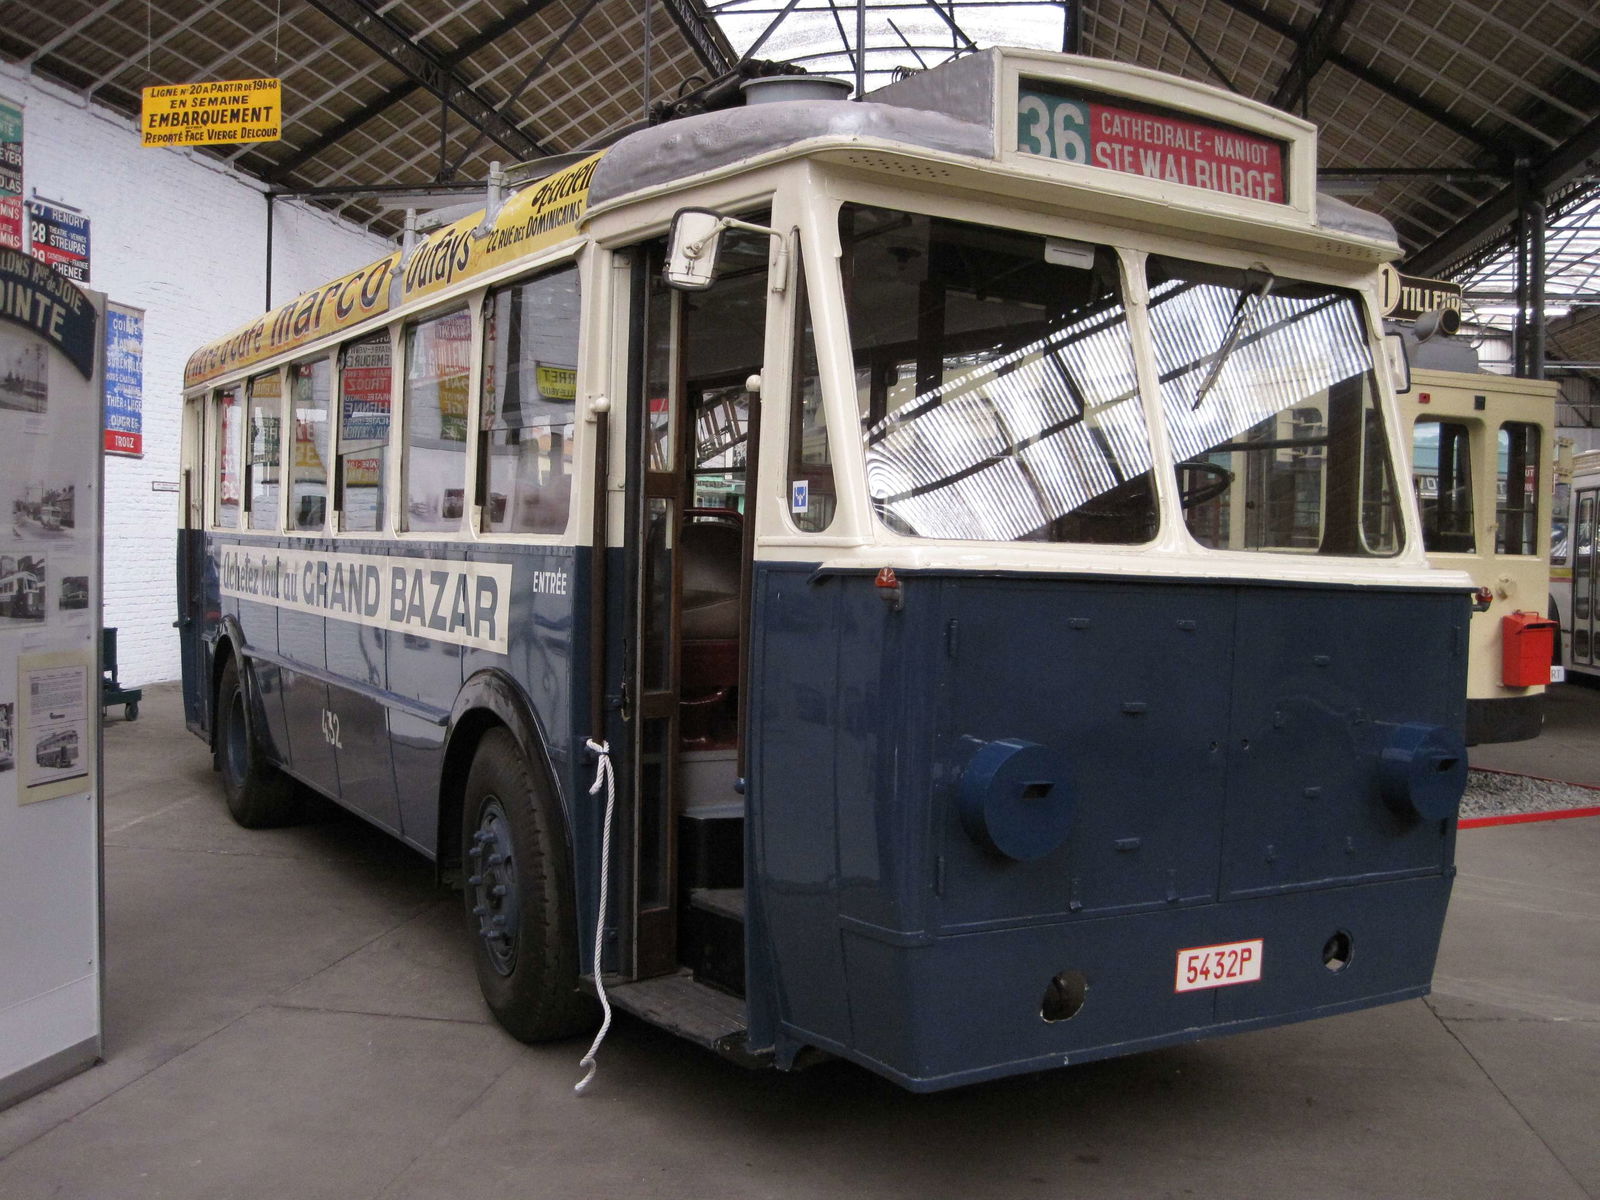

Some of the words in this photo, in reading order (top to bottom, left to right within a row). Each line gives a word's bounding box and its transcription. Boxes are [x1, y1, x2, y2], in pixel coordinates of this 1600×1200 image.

[151, 88, 178, 98] LIGNE
[189, 85, 202, 95] 20
[210, 83, 243, 93] PARTIR
[170, 99, 187, 109] EN
[191, 95, 249, 108] SEMAINE
[149, 106, 273, 129] EMBARQUEMENT
[1019, 95, 1086, 165] 36
[185, 130, 204, 142] FACE
[207, 129, 238, 140] VIERGE
[240, 127, 278, 139] DELCOUR
[1096, 142, 1134, 174] STE
[31, 221, 46, 243] 28
[52, 208, 86, 229] RENORY
[486, 229, 500, 254] 22
[498, 225, 515, 250] RUE
[526, 199, 583, 239] DOMINICAINS
[50, 235, 86, 256] STREUPAS
[55, 278, 83, 316] JOIE
[271, 258, 394, 347] marco
[1381, 268, 1389, 309] 1
[533, 567, 567, 595] ENTRÉE
[302, 560, 382, 618] GRAND
[390, 566, 499, 641] BAZAR
[322, 708, 343, 749] 432
[1187, 947, 1252, 984] 5432P
